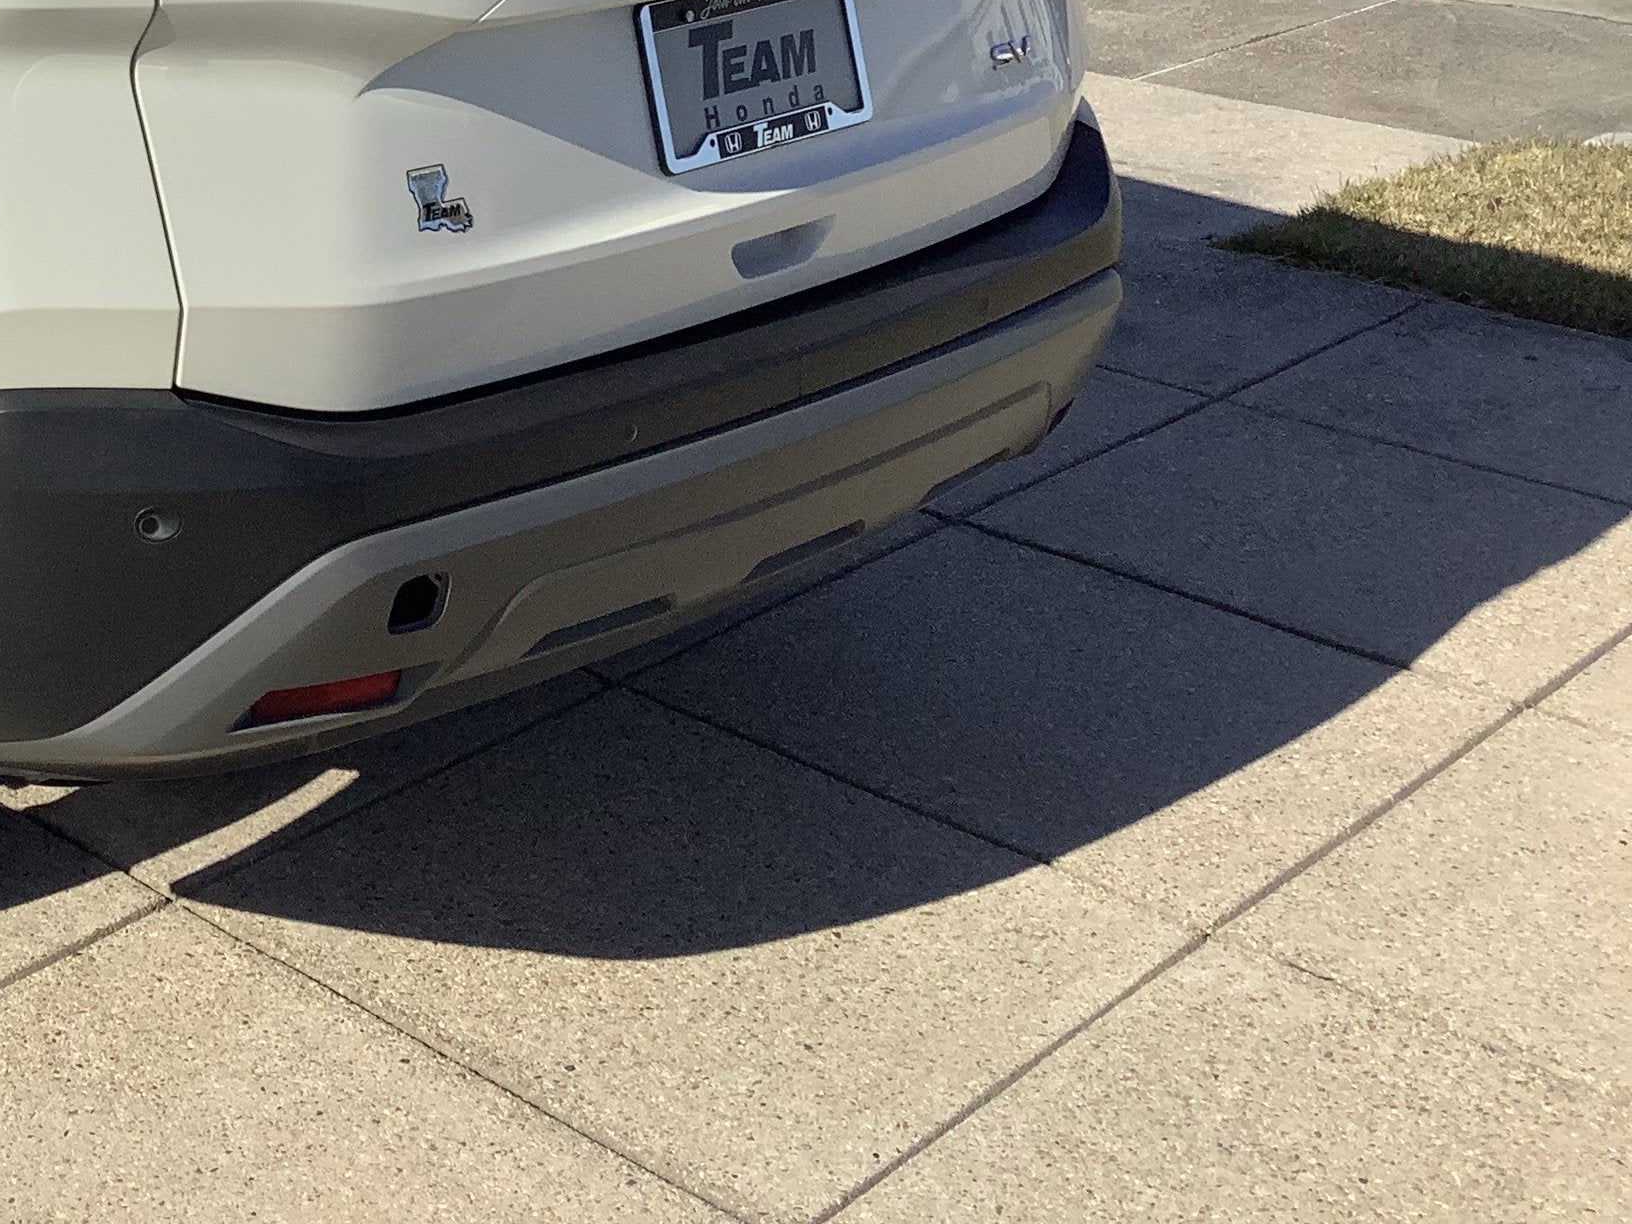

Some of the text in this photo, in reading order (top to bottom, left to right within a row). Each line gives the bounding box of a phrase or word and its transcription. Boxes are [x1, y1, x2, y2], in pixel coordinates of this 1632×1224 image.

[688, 20, 817, 101] TEAM
[989, 35, 1032, 71] SV
[703, 84, 825, 129] Honda
[753, 123, 794, 148] TEAM
[422, 201, 461, 222] TEAM
